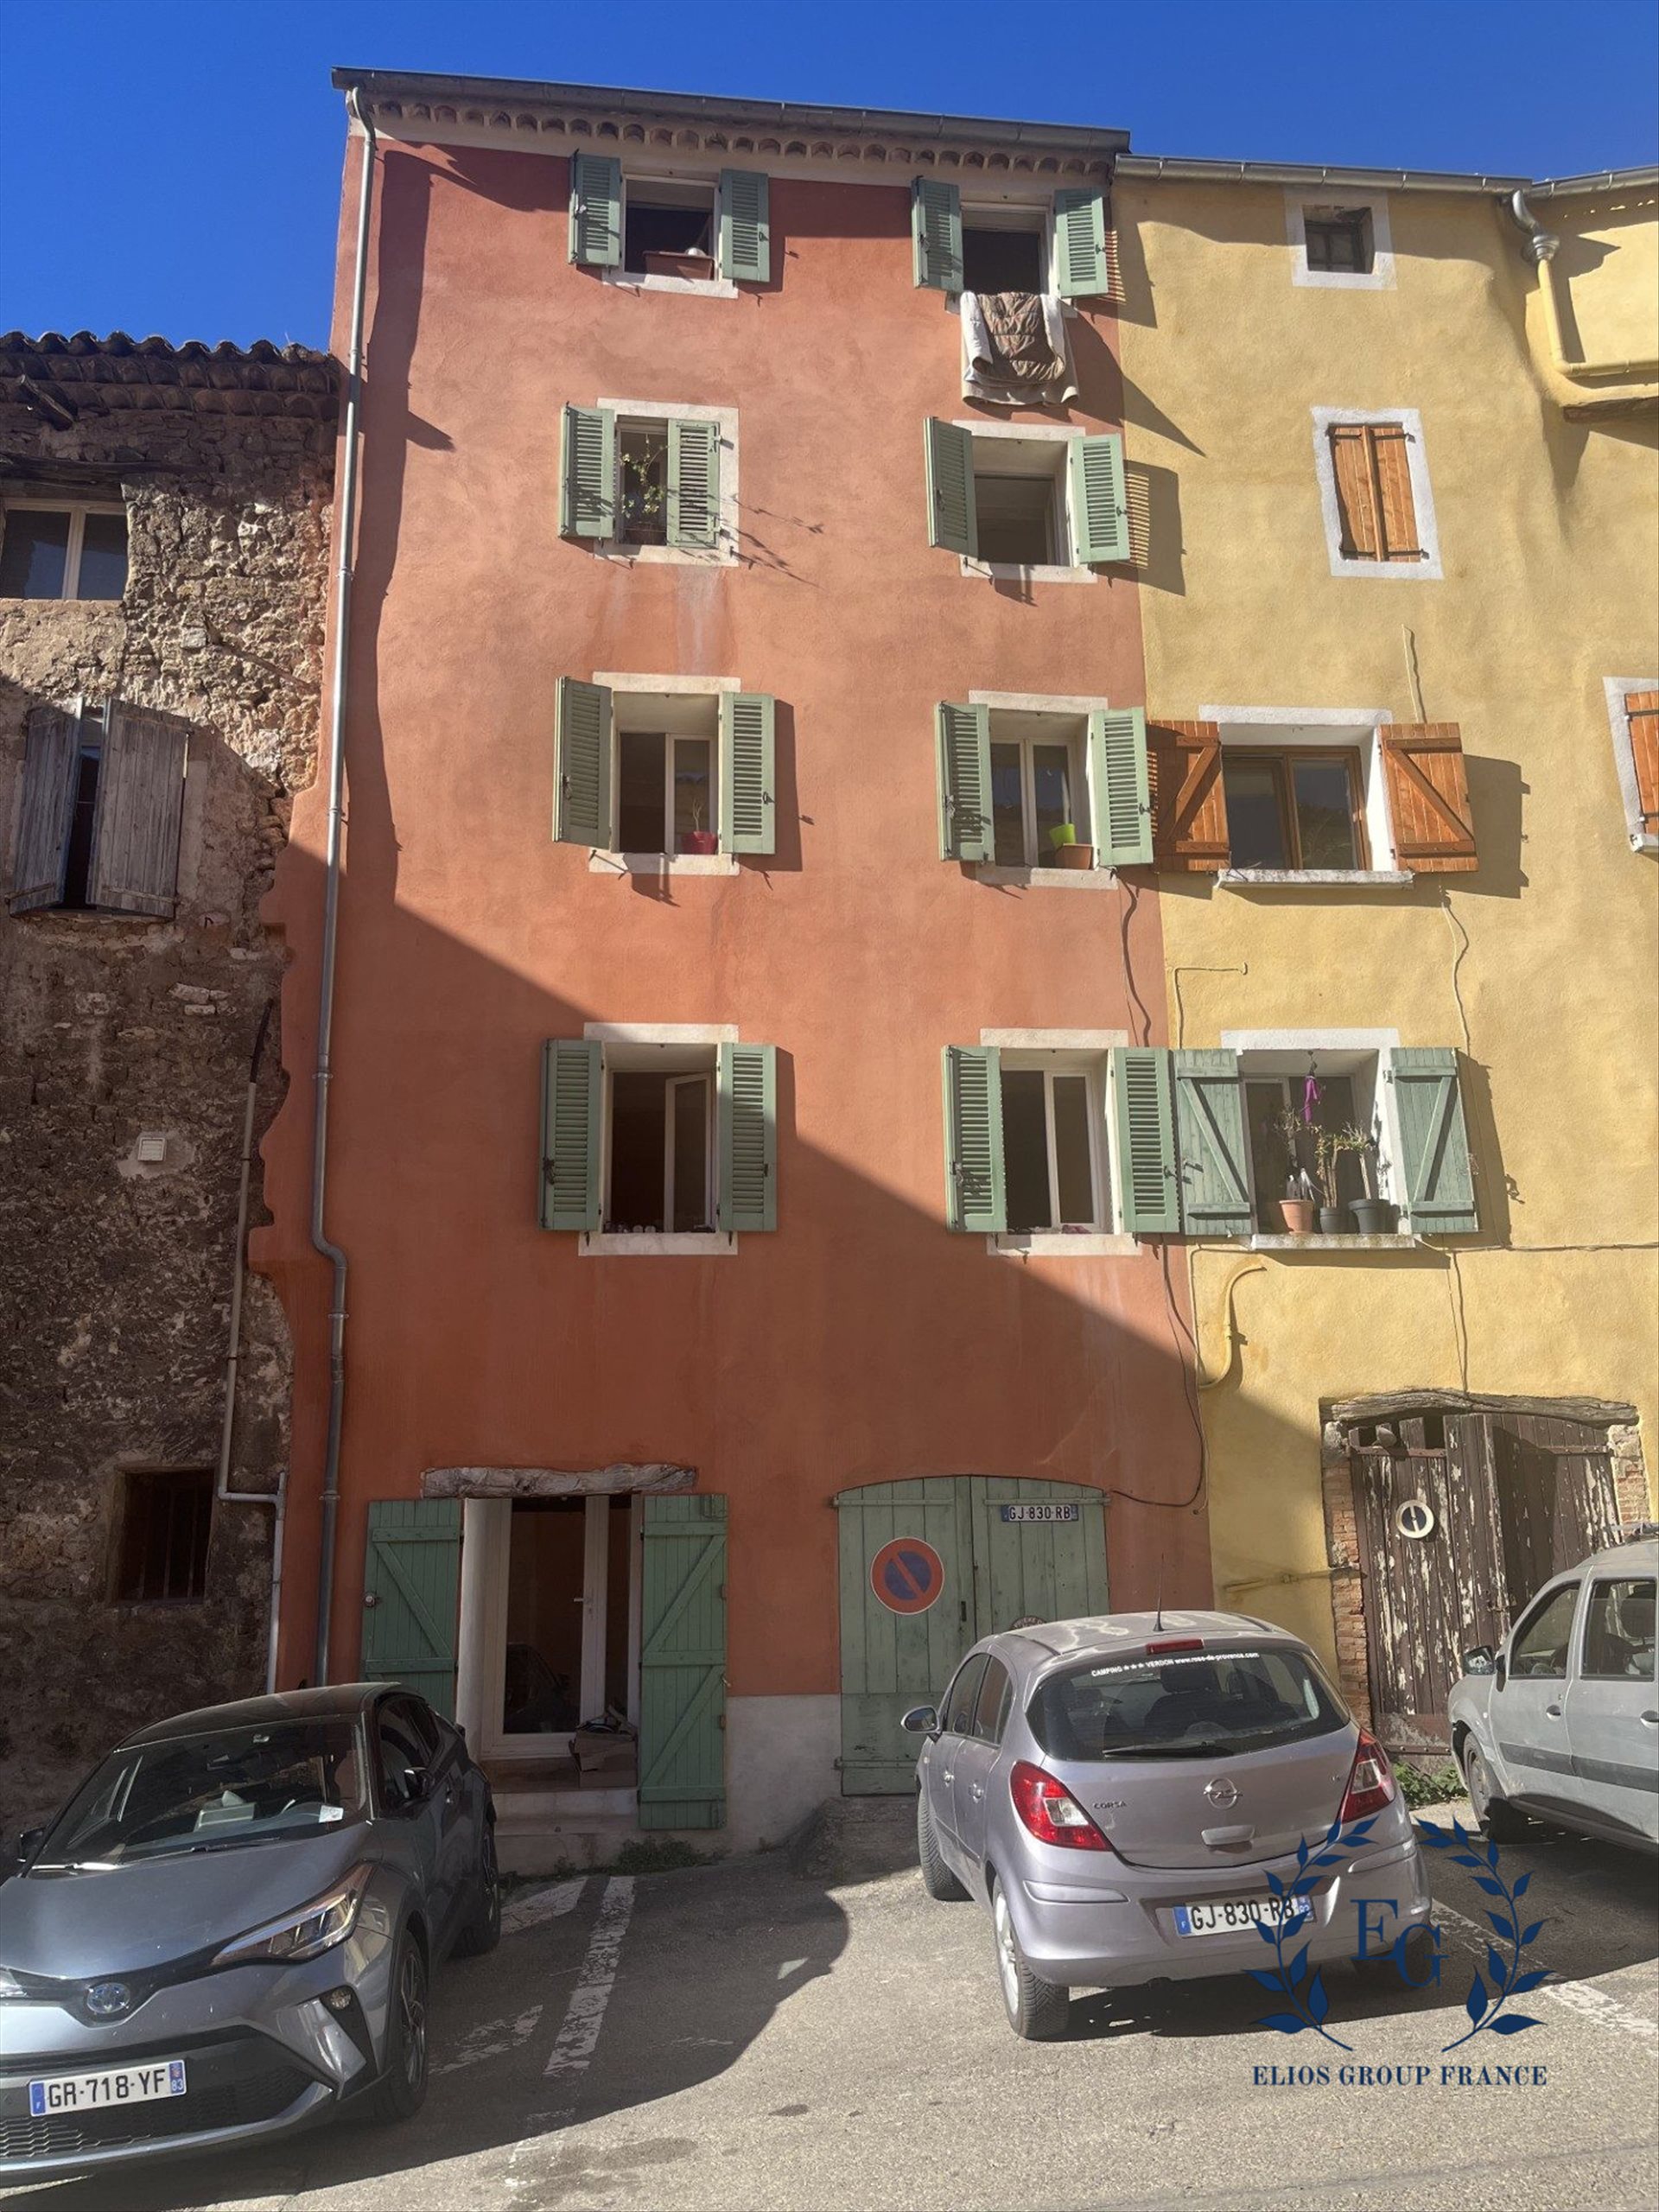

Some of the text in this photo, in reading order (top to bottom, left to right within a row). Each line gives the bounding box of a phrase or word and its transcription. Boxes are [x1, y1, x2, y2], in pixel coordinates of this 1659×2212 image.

[1009, 1506, 1071, 1520] GJ-830-RB
[1091, 1665, 1123, 1677] CAMPING
[48, 2069, 166, 2107] GR-718-YF
[171, 2078, 184, 2092] 83
